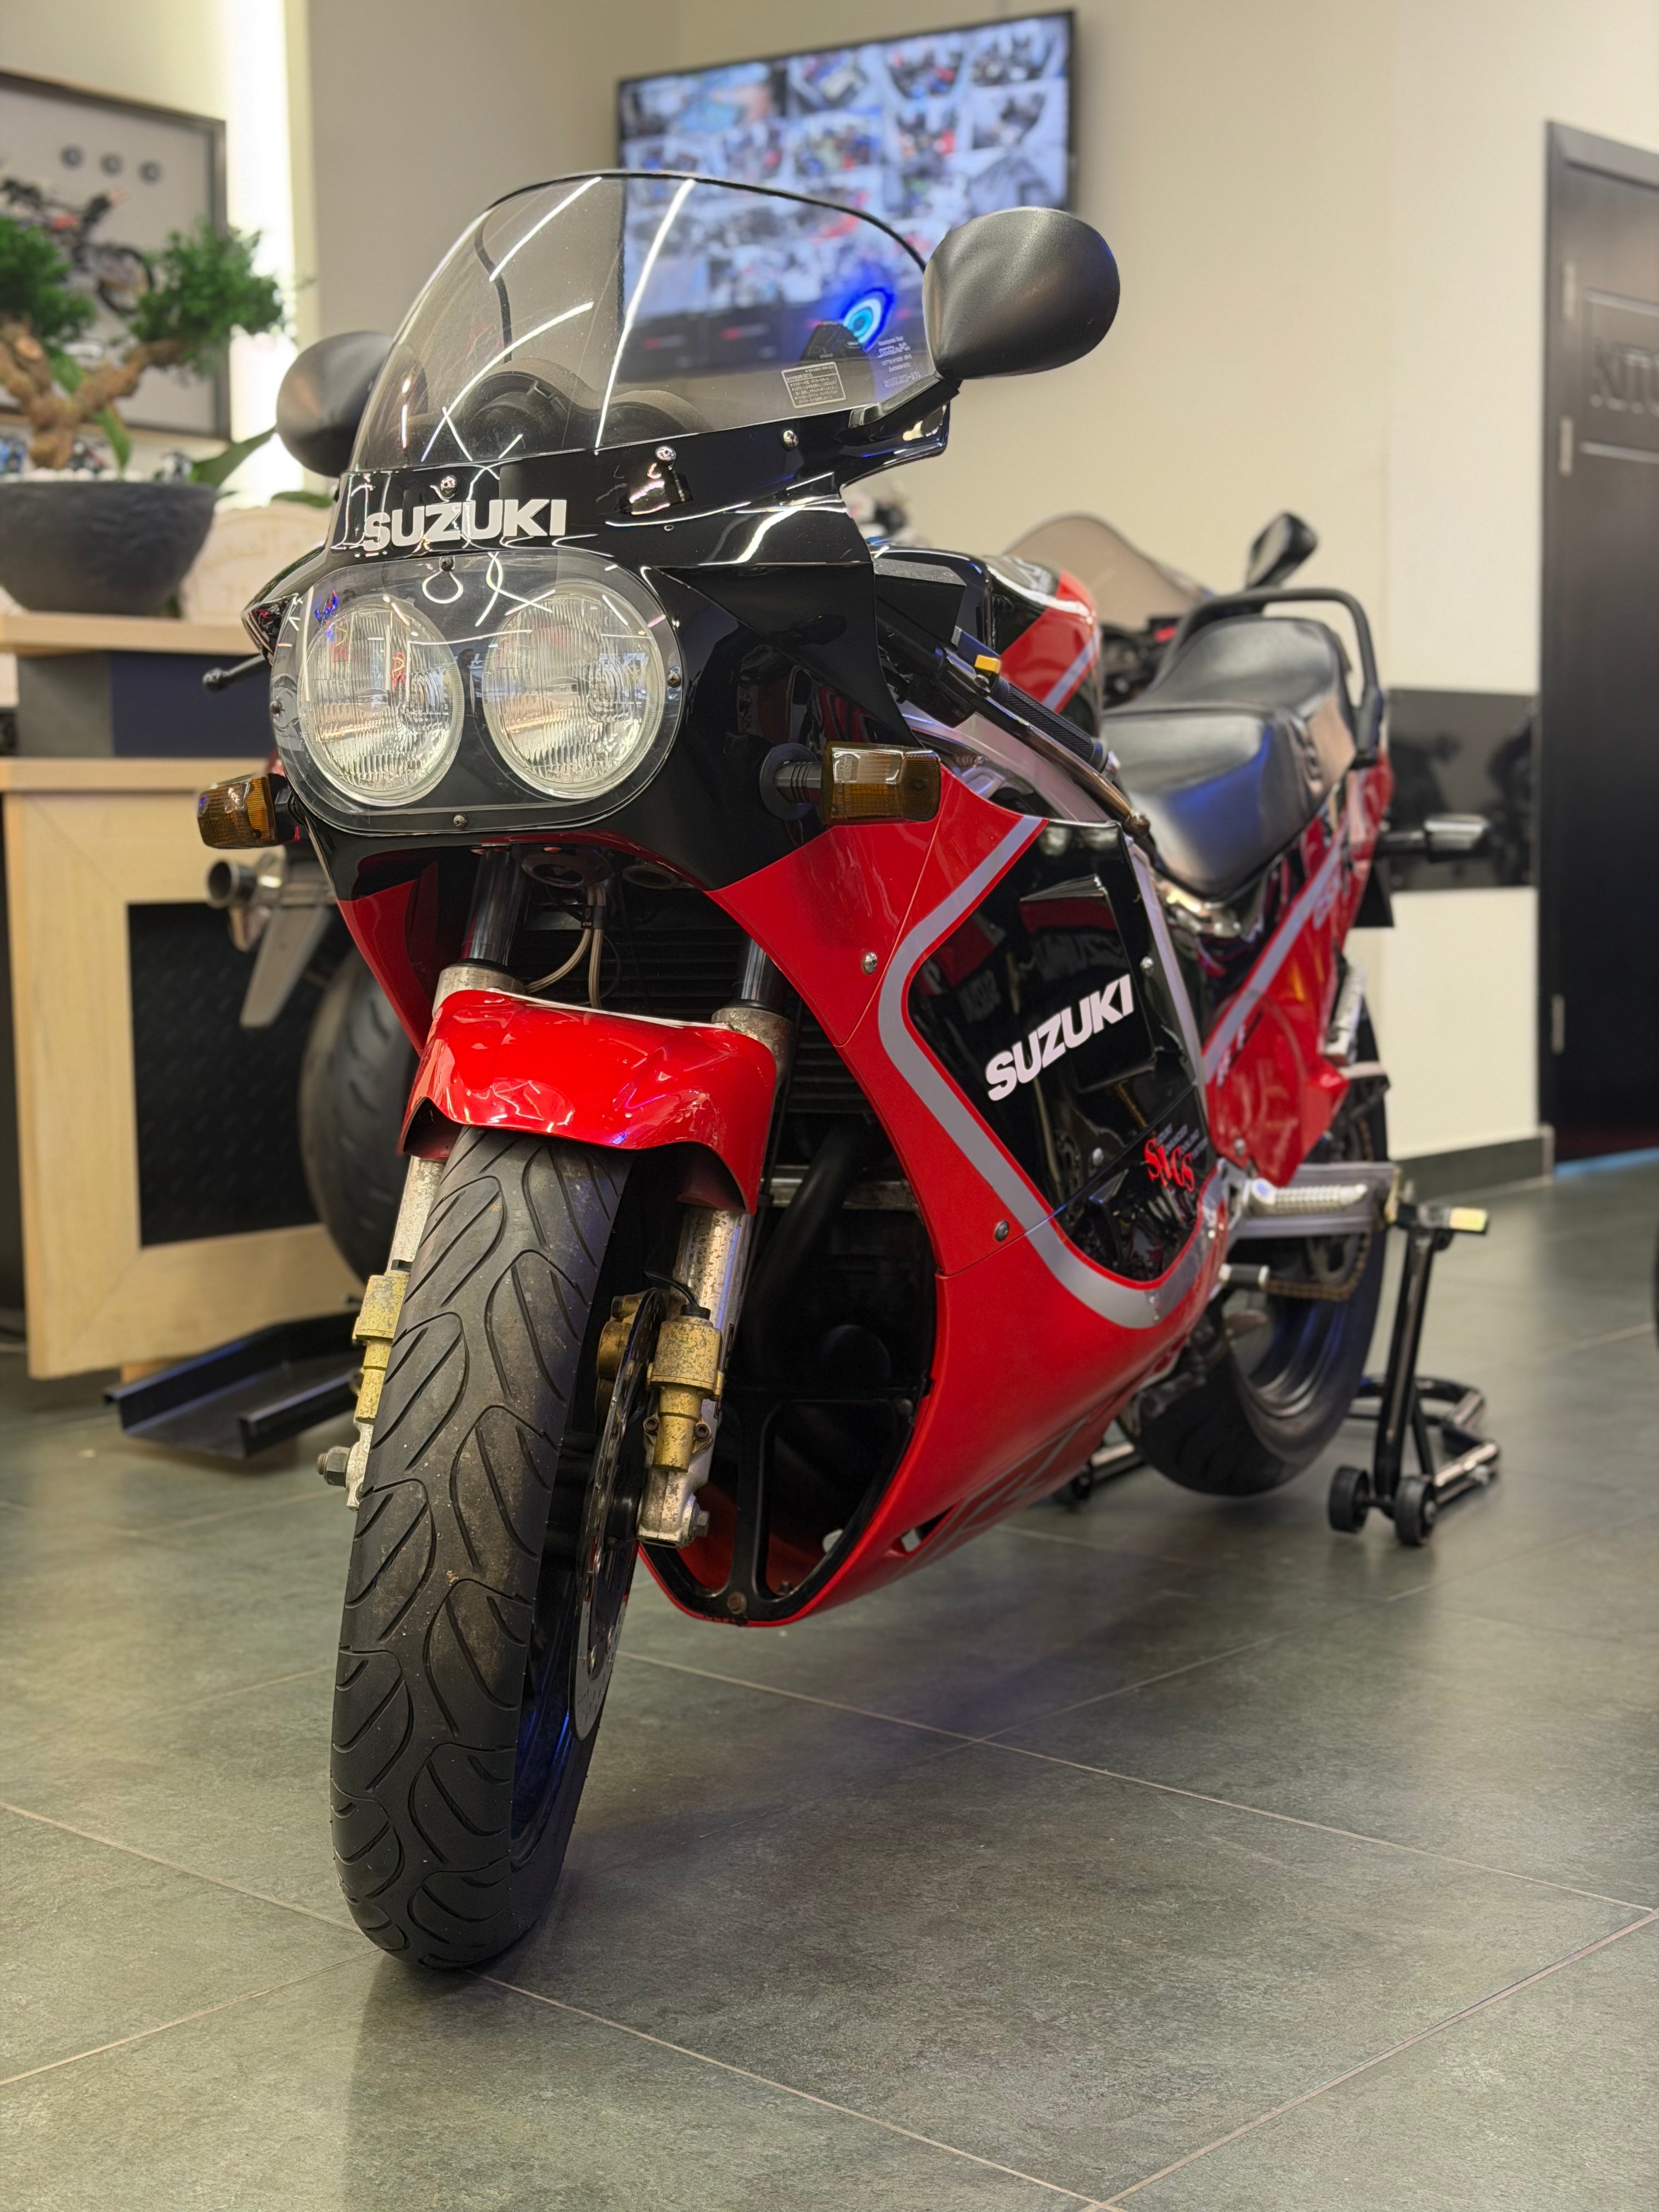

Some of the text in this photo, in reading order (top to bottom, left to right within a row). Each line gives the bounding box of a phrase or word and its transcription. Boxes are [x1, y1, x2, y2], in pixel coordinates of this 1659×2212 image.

[363, 499, 567, 551] SUZUKI
[986, 973, 1134, 1101] SUZUKI
[1144, 1137, 1195, 1193] SACS
